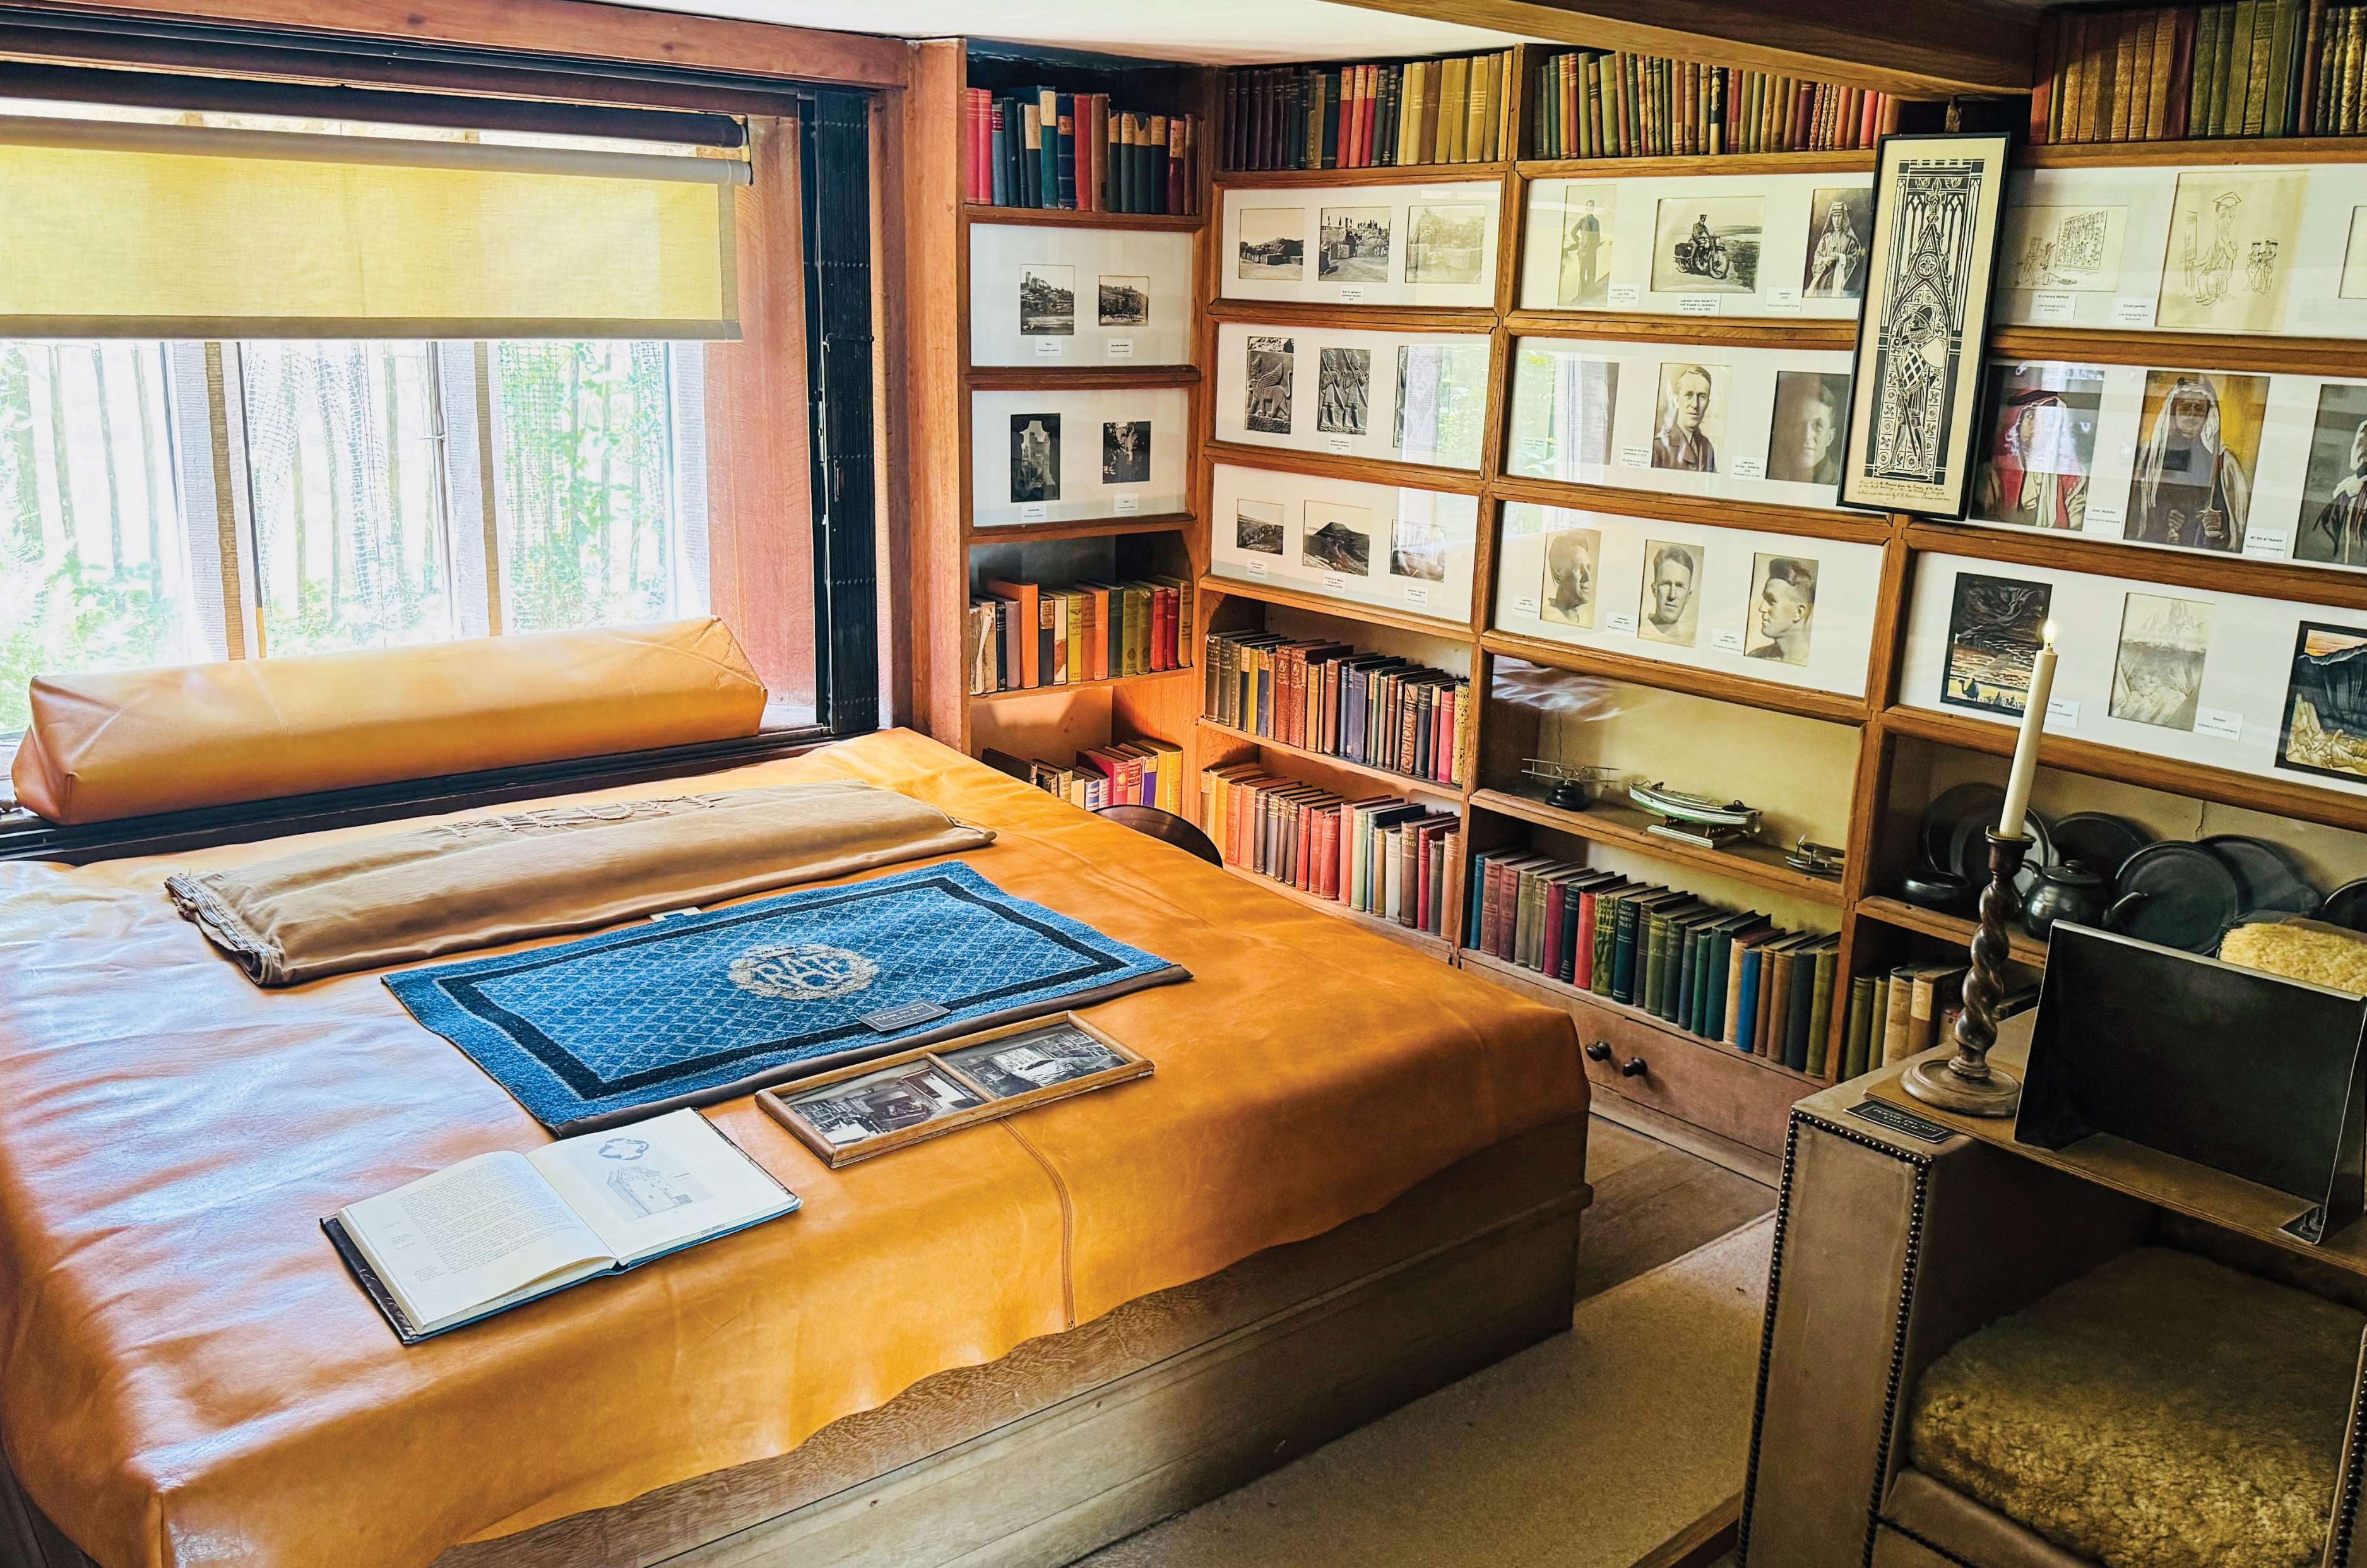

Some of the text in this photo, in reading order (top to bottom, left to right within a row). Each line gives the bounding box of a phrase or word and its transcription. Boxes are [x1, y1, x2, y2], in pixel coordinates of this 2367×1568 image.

[891, 1011, 919, 1021] TOUCH
[1873, 1109, 1902, 1120] PLEASE
[1883, 1116, 1919, 1129] TOUCH
